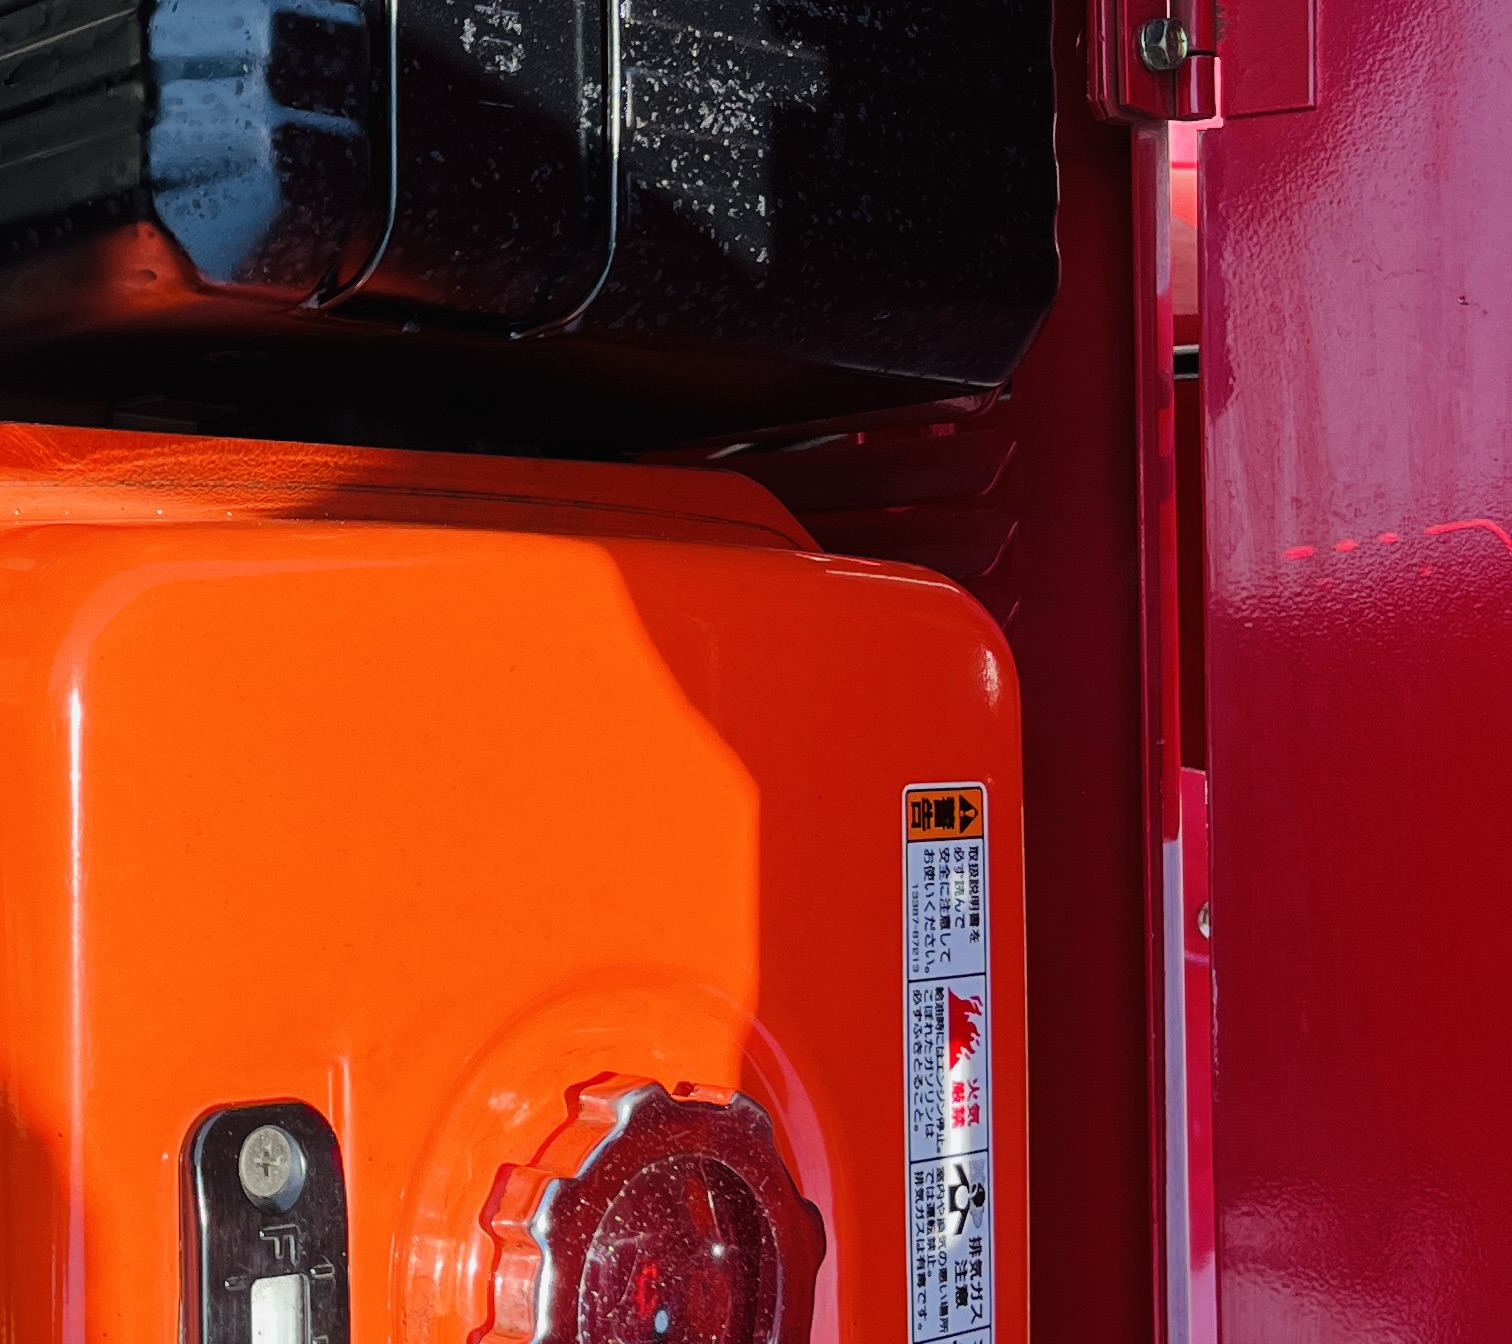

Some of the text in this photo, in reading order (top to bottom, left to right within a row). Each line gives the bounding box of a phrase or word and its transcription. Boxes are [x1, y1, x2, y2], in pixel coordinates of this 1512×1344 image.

[923, 849, 936, 974] お使いください。
[939, 847, 951, 962] 安全に注意して
[954, 847, 965, 929] 必ず読んで
[969, 846, 980, 944] 取扱説明書を
[913, 990, 923, 1132] 必ずふきとること。
[924, 990, 934, 1138] こぼれたガソリンは
[952, 1081, 965, 1128] 厳禁
[967, 1078, 980, 1127] 火気
[258, 1222, 300, 1267] F
[914, 1171, 927, 1331] 排気ガスは有毒です。
[926, 1169, 936, 1278] では運転禁止。
[936, 1167, 949, 1334] 室内や換気の悪い場所
[954, 1260, 968, 1309] 注意
[969, 1236, 983, 1324] 排気ガス
